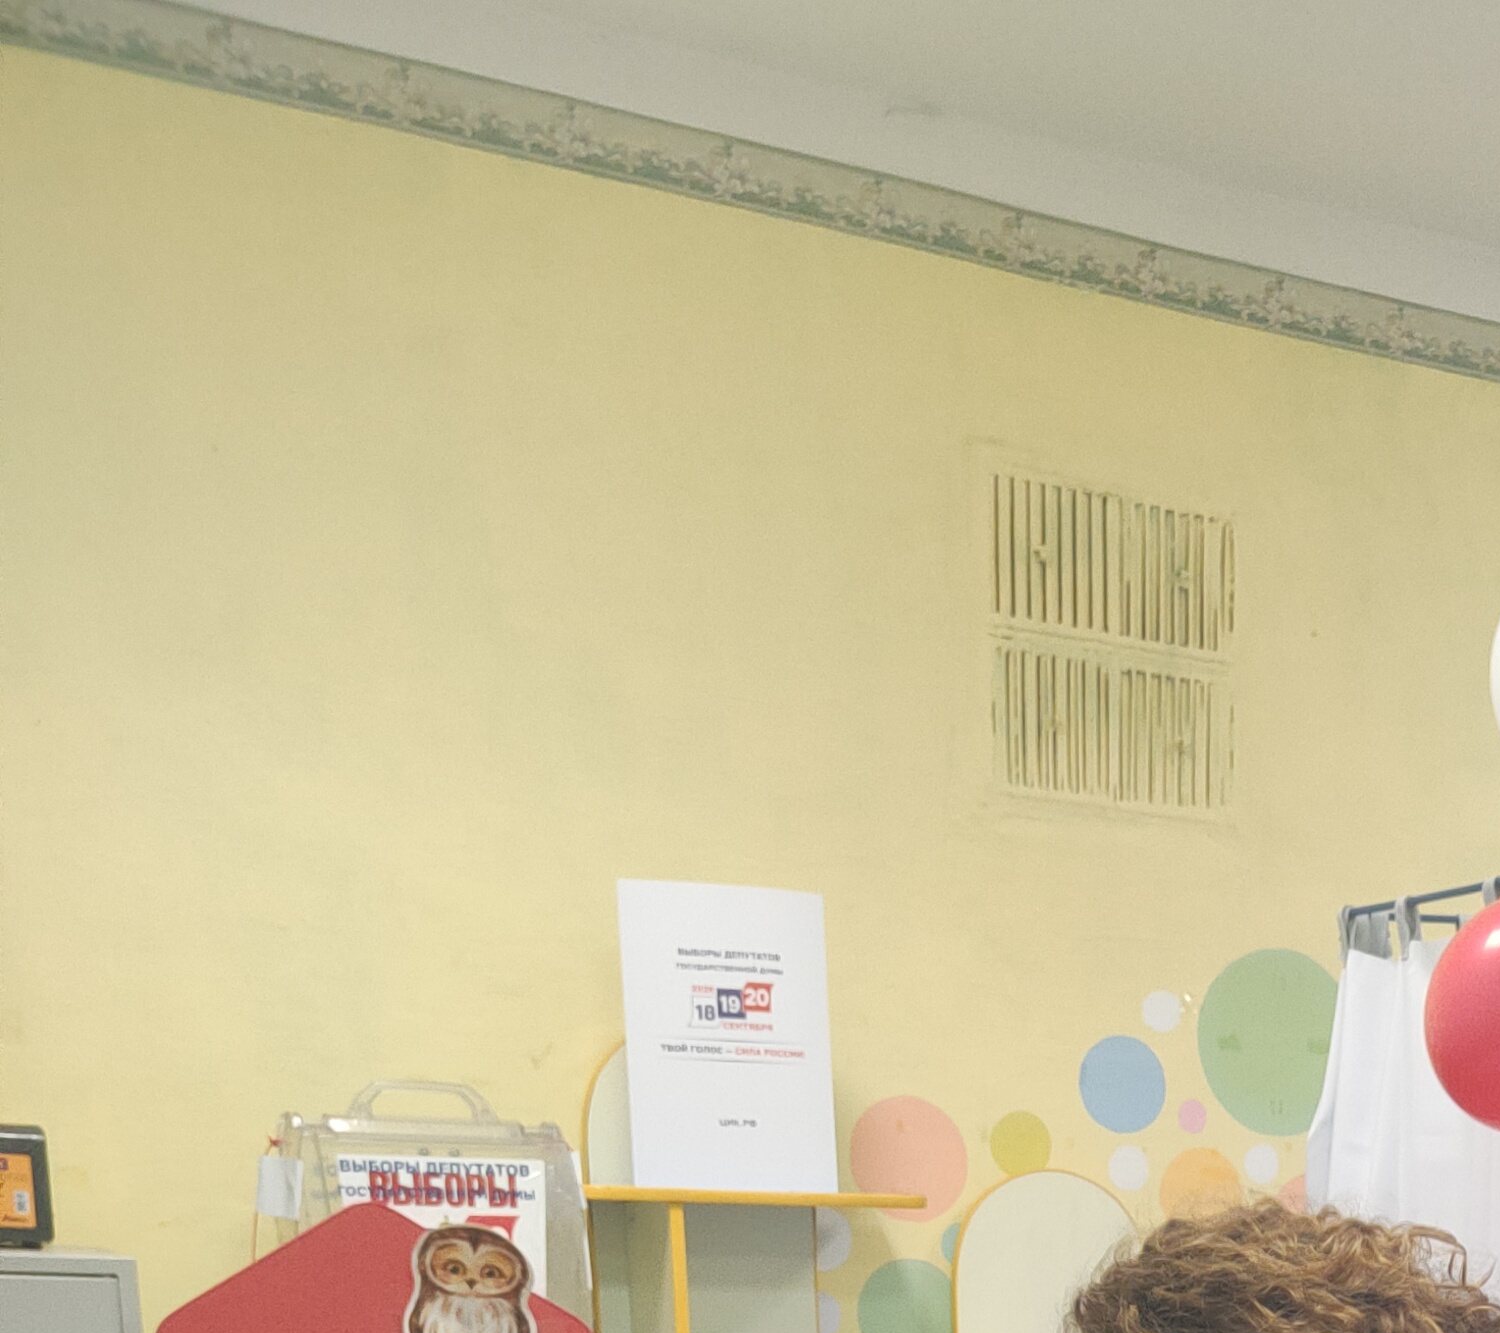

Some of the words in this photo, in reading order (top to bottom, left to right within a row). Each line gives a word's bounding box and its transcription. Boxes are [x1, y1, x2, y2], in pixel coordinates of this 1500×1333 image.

[695, 1004, 716, 1021] 18
[720, 995, 740, 1014] 19
[743, 988, 769, 1007] 20
[369, 1170, 518, 1208] ВЫБОРЫ
